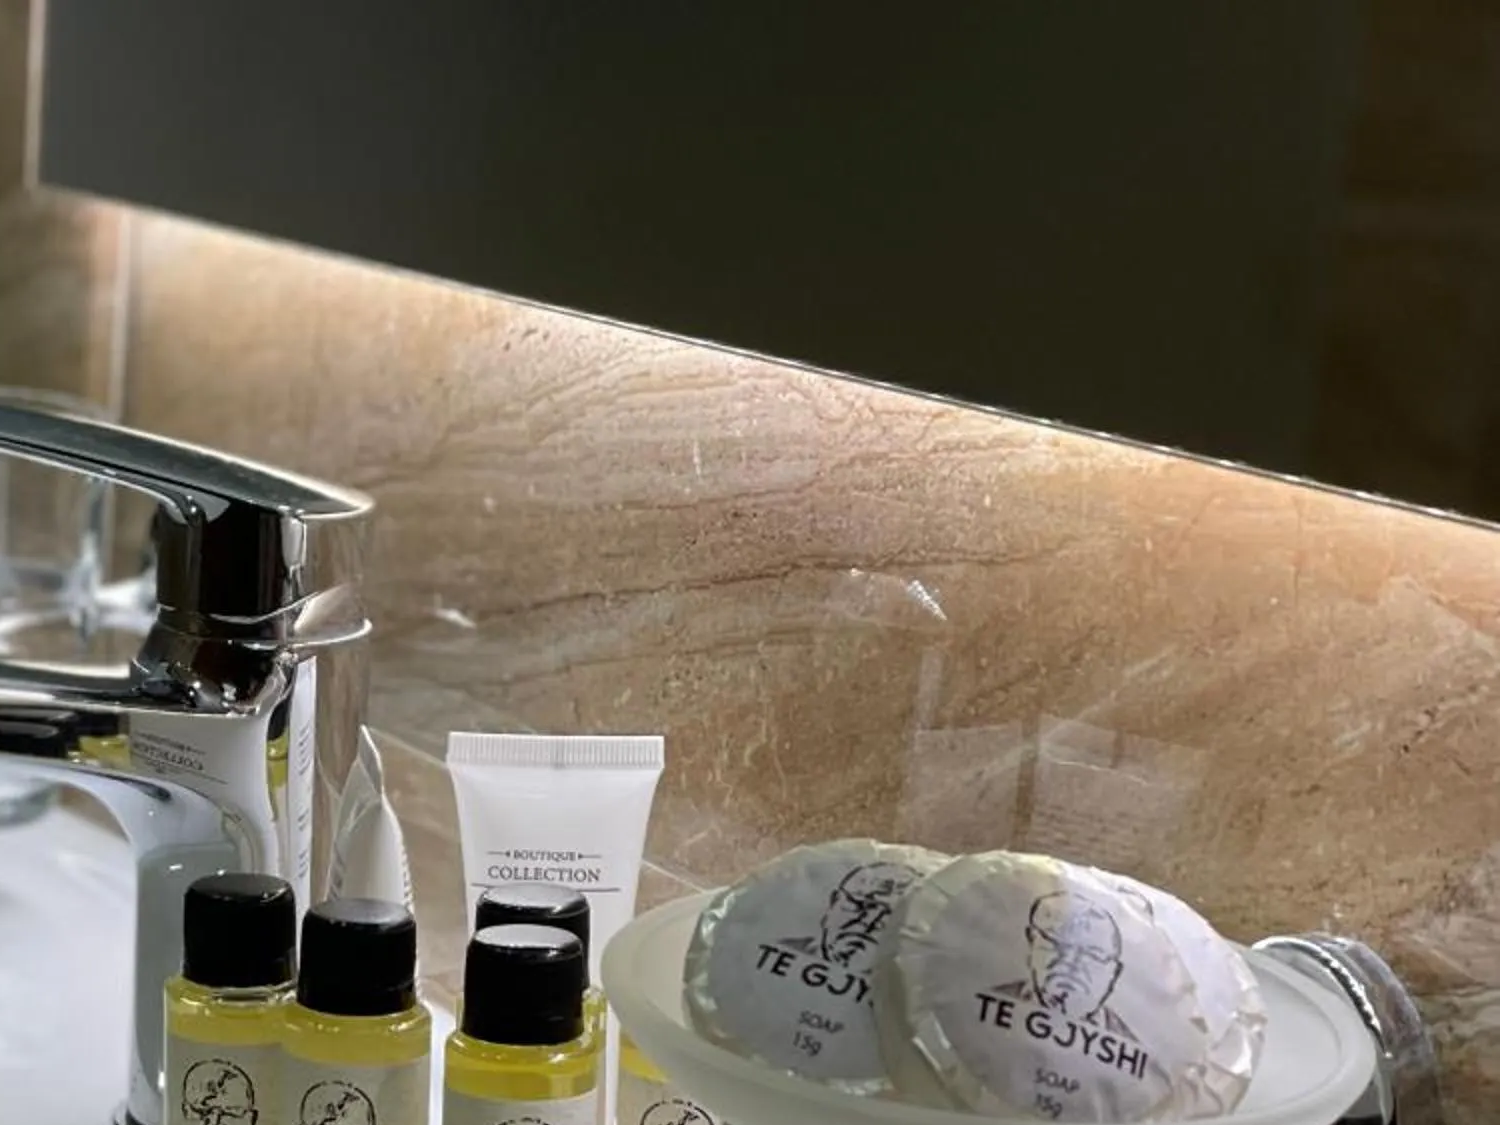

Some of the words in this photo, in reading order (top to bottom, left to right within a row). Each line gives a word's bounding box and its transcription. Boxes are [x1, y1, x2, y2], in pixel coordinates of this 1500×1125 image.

[514, 849, 576, 862] BOUTIQUE
[488, 865, 601, 882] COLLECTION
[756, 944, 796, 977] TE
[802, 963, 871, 1004] GJY
[800, 1010, 844, 1034] SOAP
[793, 1031, 822, 1057] 15g
[975, 993, 1015, 1029] TE
[1026, 1011, 1149, 1080] GJYSHI
[1035, 1067, 1080, 1094] SOAP
